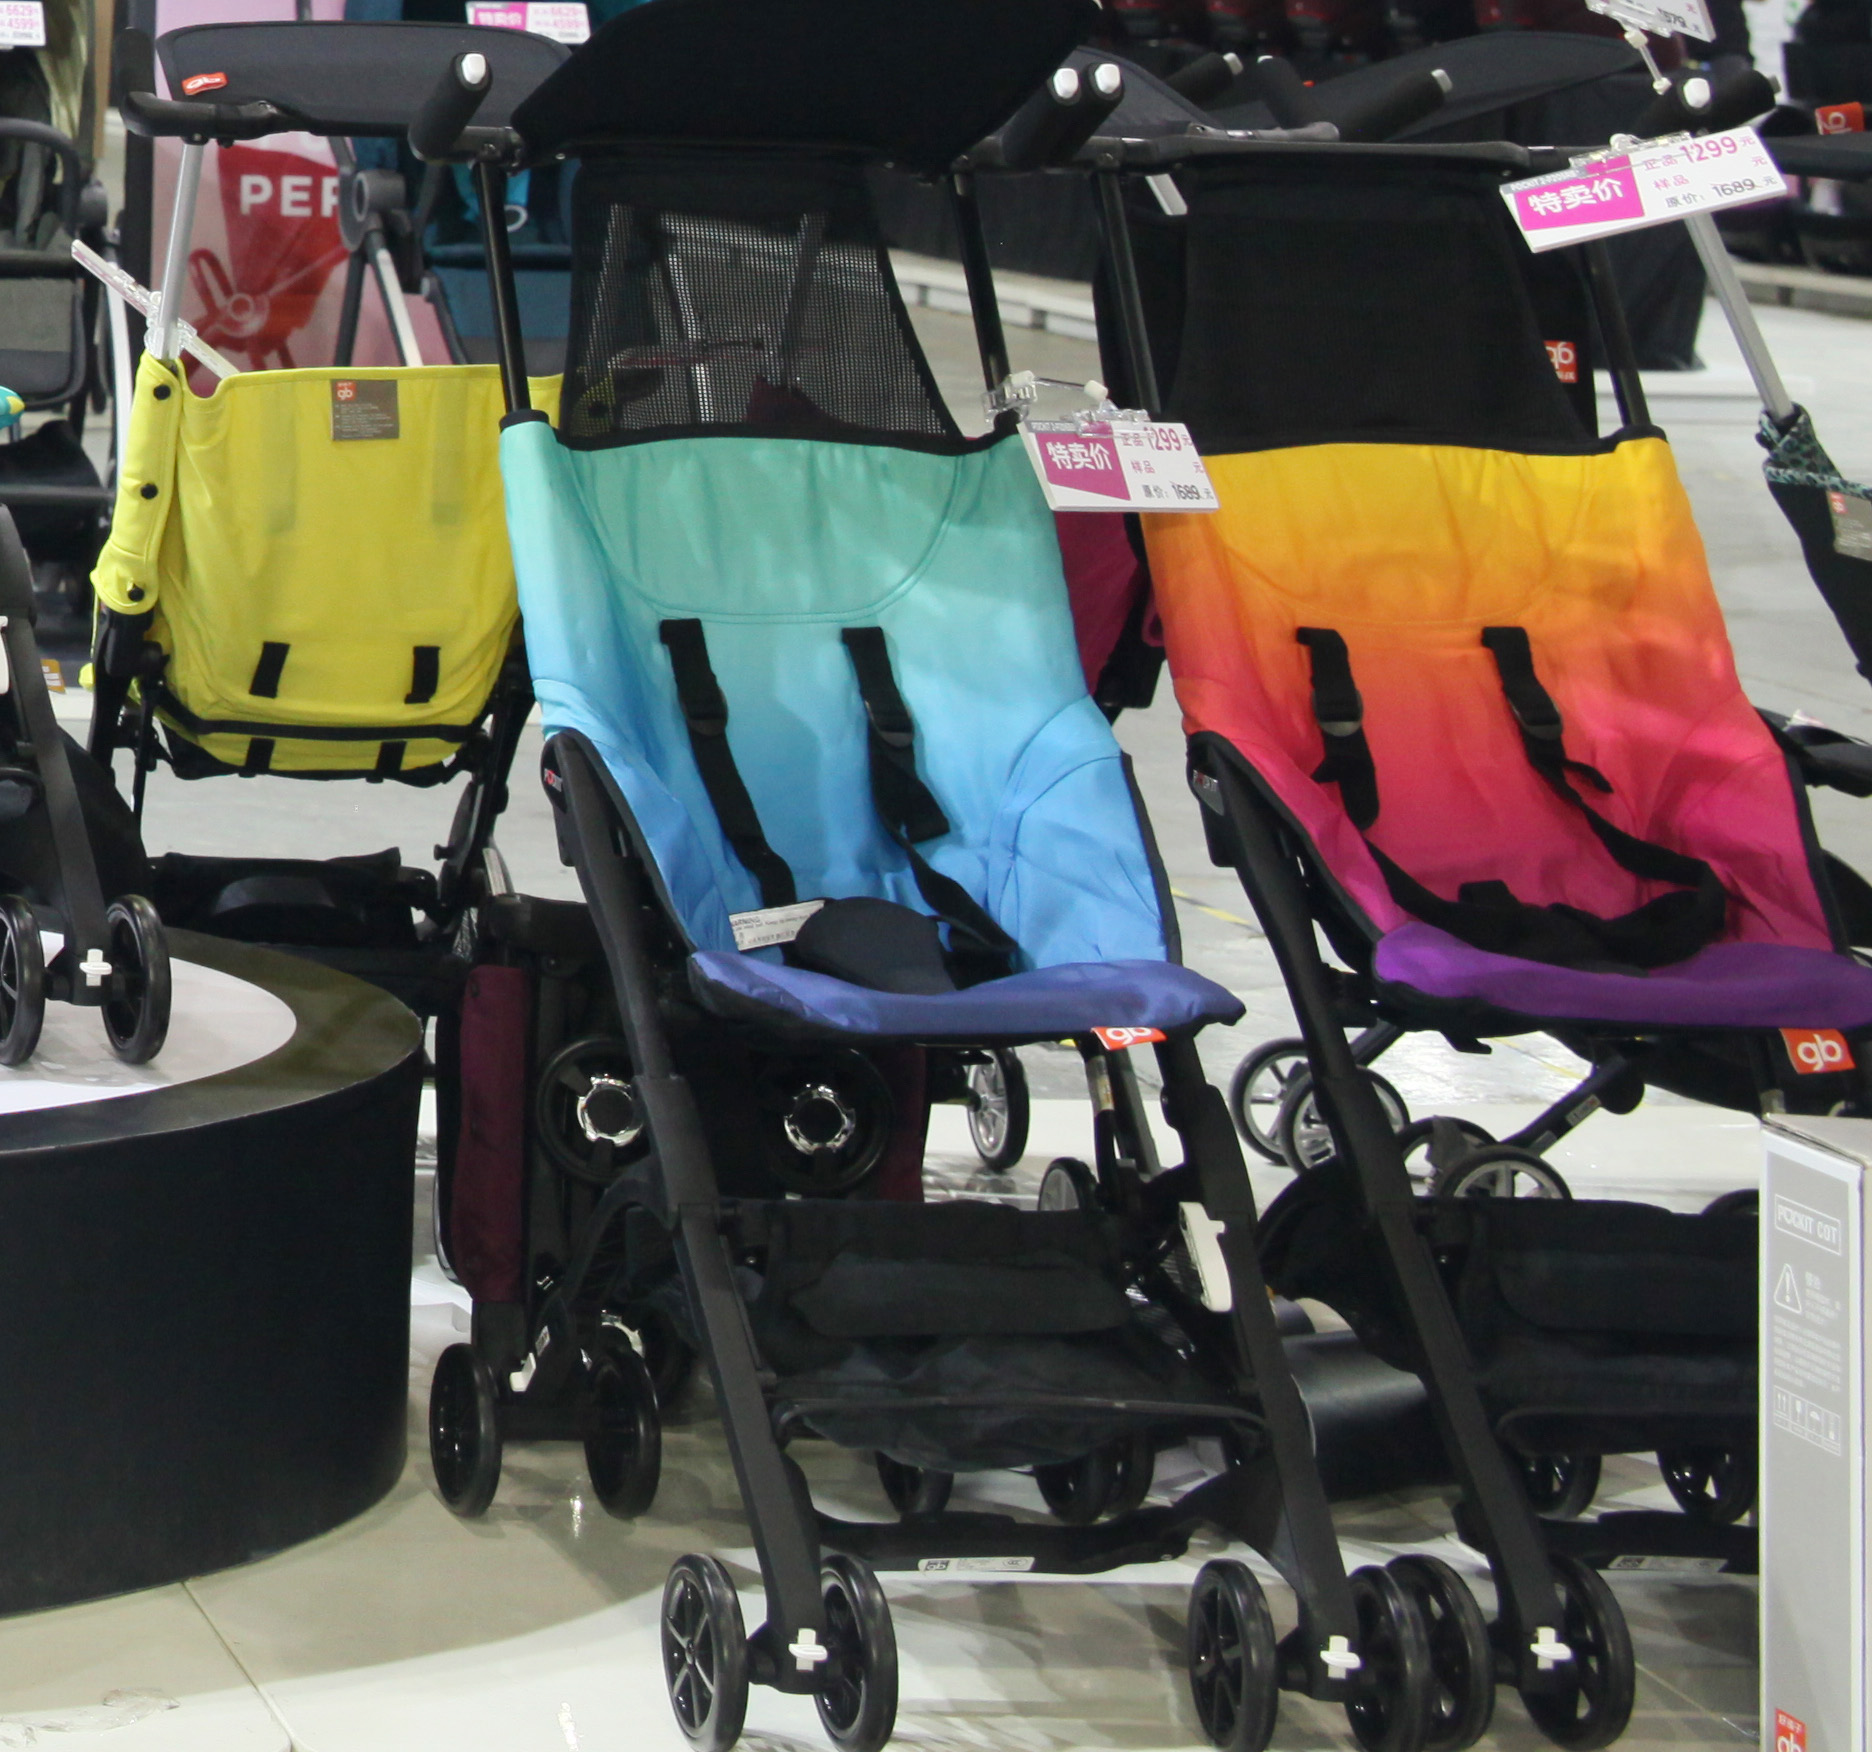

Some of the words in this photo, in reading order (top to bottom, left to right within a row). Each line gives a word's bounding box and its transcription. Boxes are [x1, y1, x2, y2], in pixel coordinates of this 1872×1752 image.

[1678, 135, 1738, 164] 1299
[1527, 176, 1626, 217] 特卖价
[1711, 178, 1755, 198] 1689
[1144, 427, 1182, 451] 1299
[1045, 441, 1113, 471] 特卖价
[1171, 484, 1200, 501] 1689
[1797, 1033, 1842, 1072] gb
